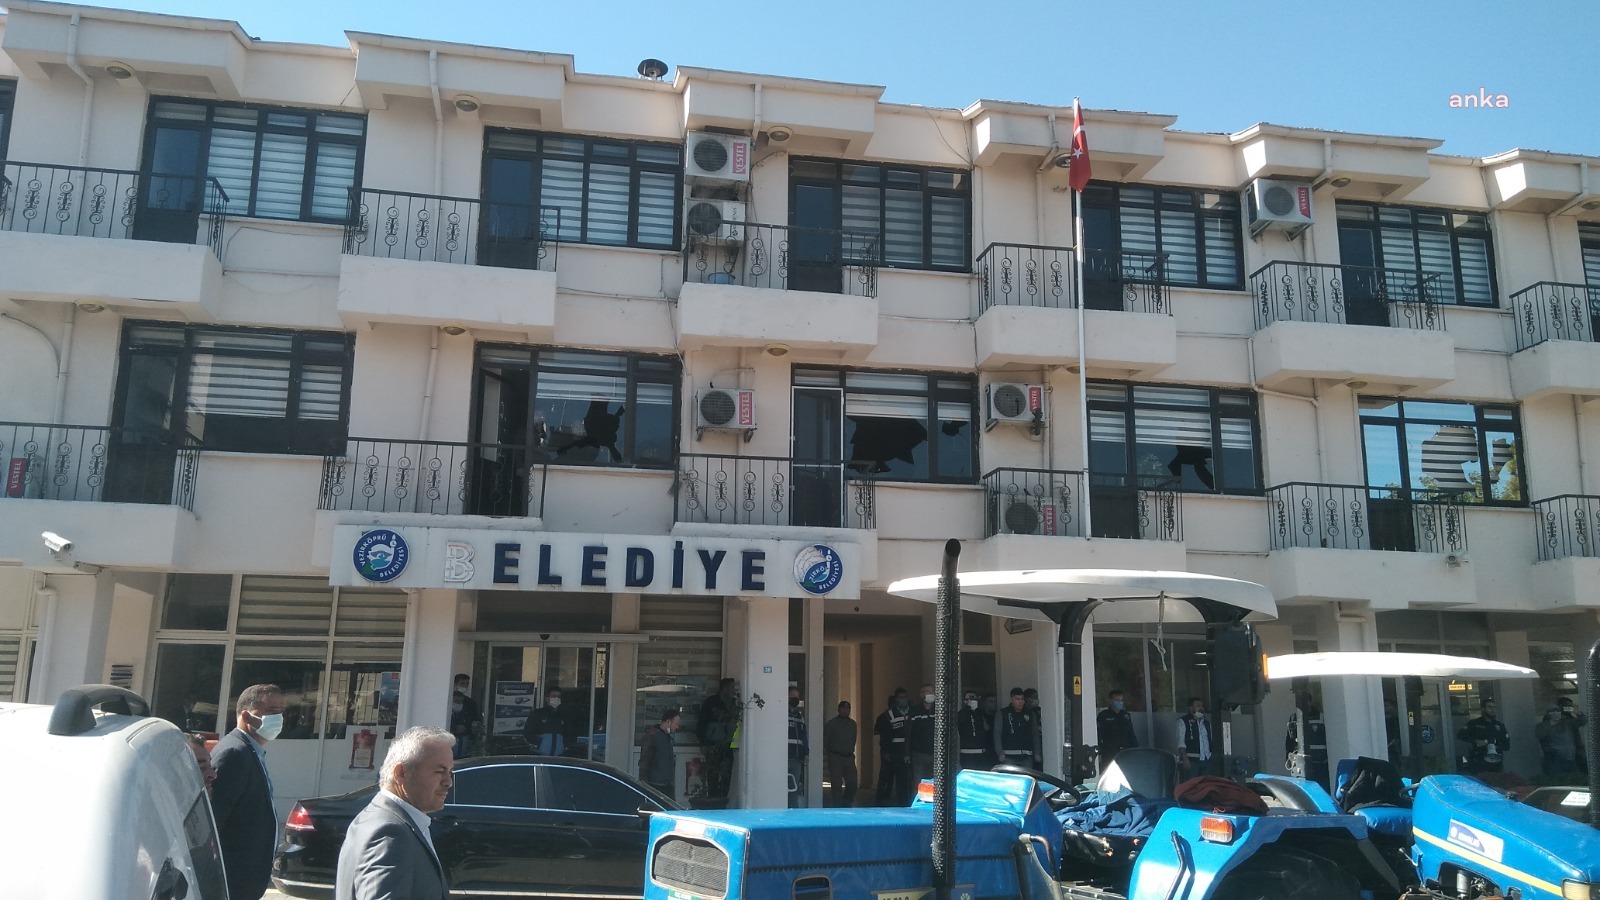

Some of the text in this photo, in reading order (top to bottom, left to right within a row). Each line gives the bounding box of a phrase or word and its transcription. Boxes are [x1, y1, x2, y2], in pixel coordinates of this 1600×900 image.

[736, 145, 745, 172] VESTEL
[741, 392, 749, 424] VESTEL
[11, 461, 22, 488] VESTEL
[358, 534, 405, 578] VEZİRKÖPRÜ BELEDİYESİ
[444, 541, 765, 592] BELEDİYE
